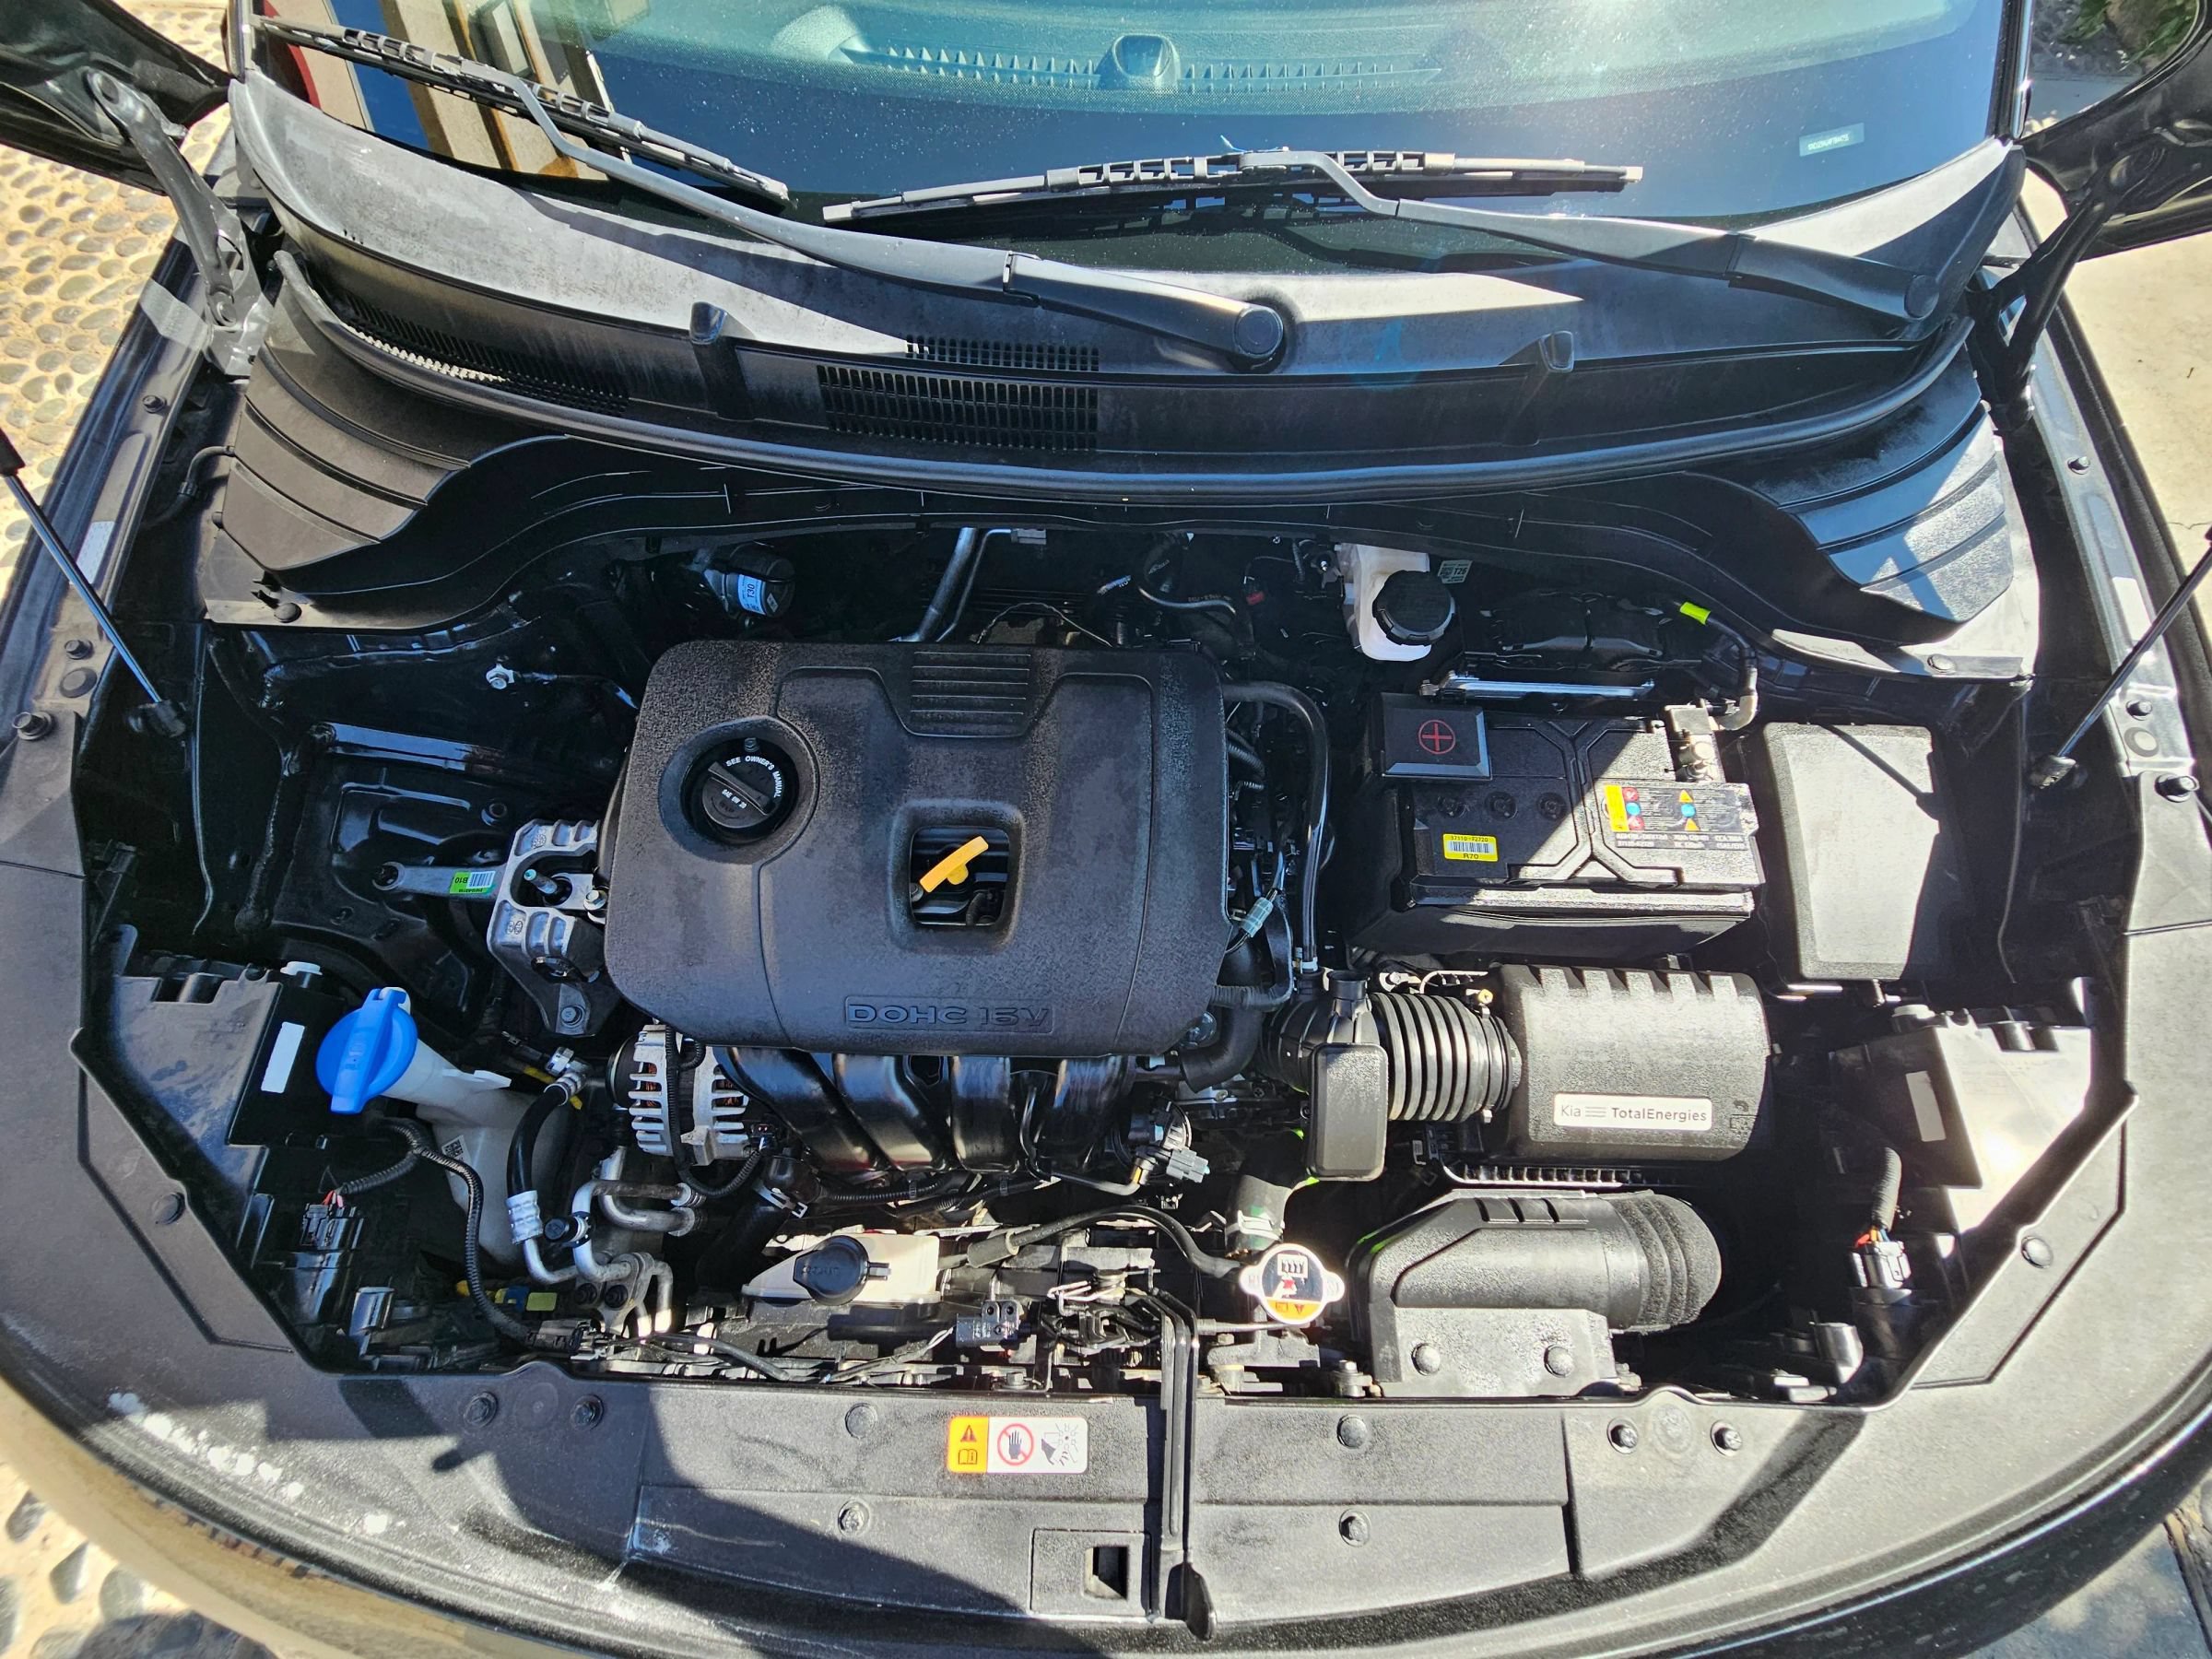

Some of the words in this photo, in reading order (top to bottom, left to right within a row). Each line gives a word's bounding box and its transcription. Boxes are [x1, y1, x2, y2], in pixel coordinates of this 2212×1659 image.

[747, 583, 756, 598] T30
[725, 757, 741, 767] SEE
[745, 755, 775, 771] OWNER'S
[772, 771, 783, 798] MANUAL
[848, 1003, 967, 1025] DOHC
[980, 1006, 1049, 1027] 16V
[1560, 1104, 1582, 1117] Kia
[1611, 1107, 1707, 1123] TotalEnergies
